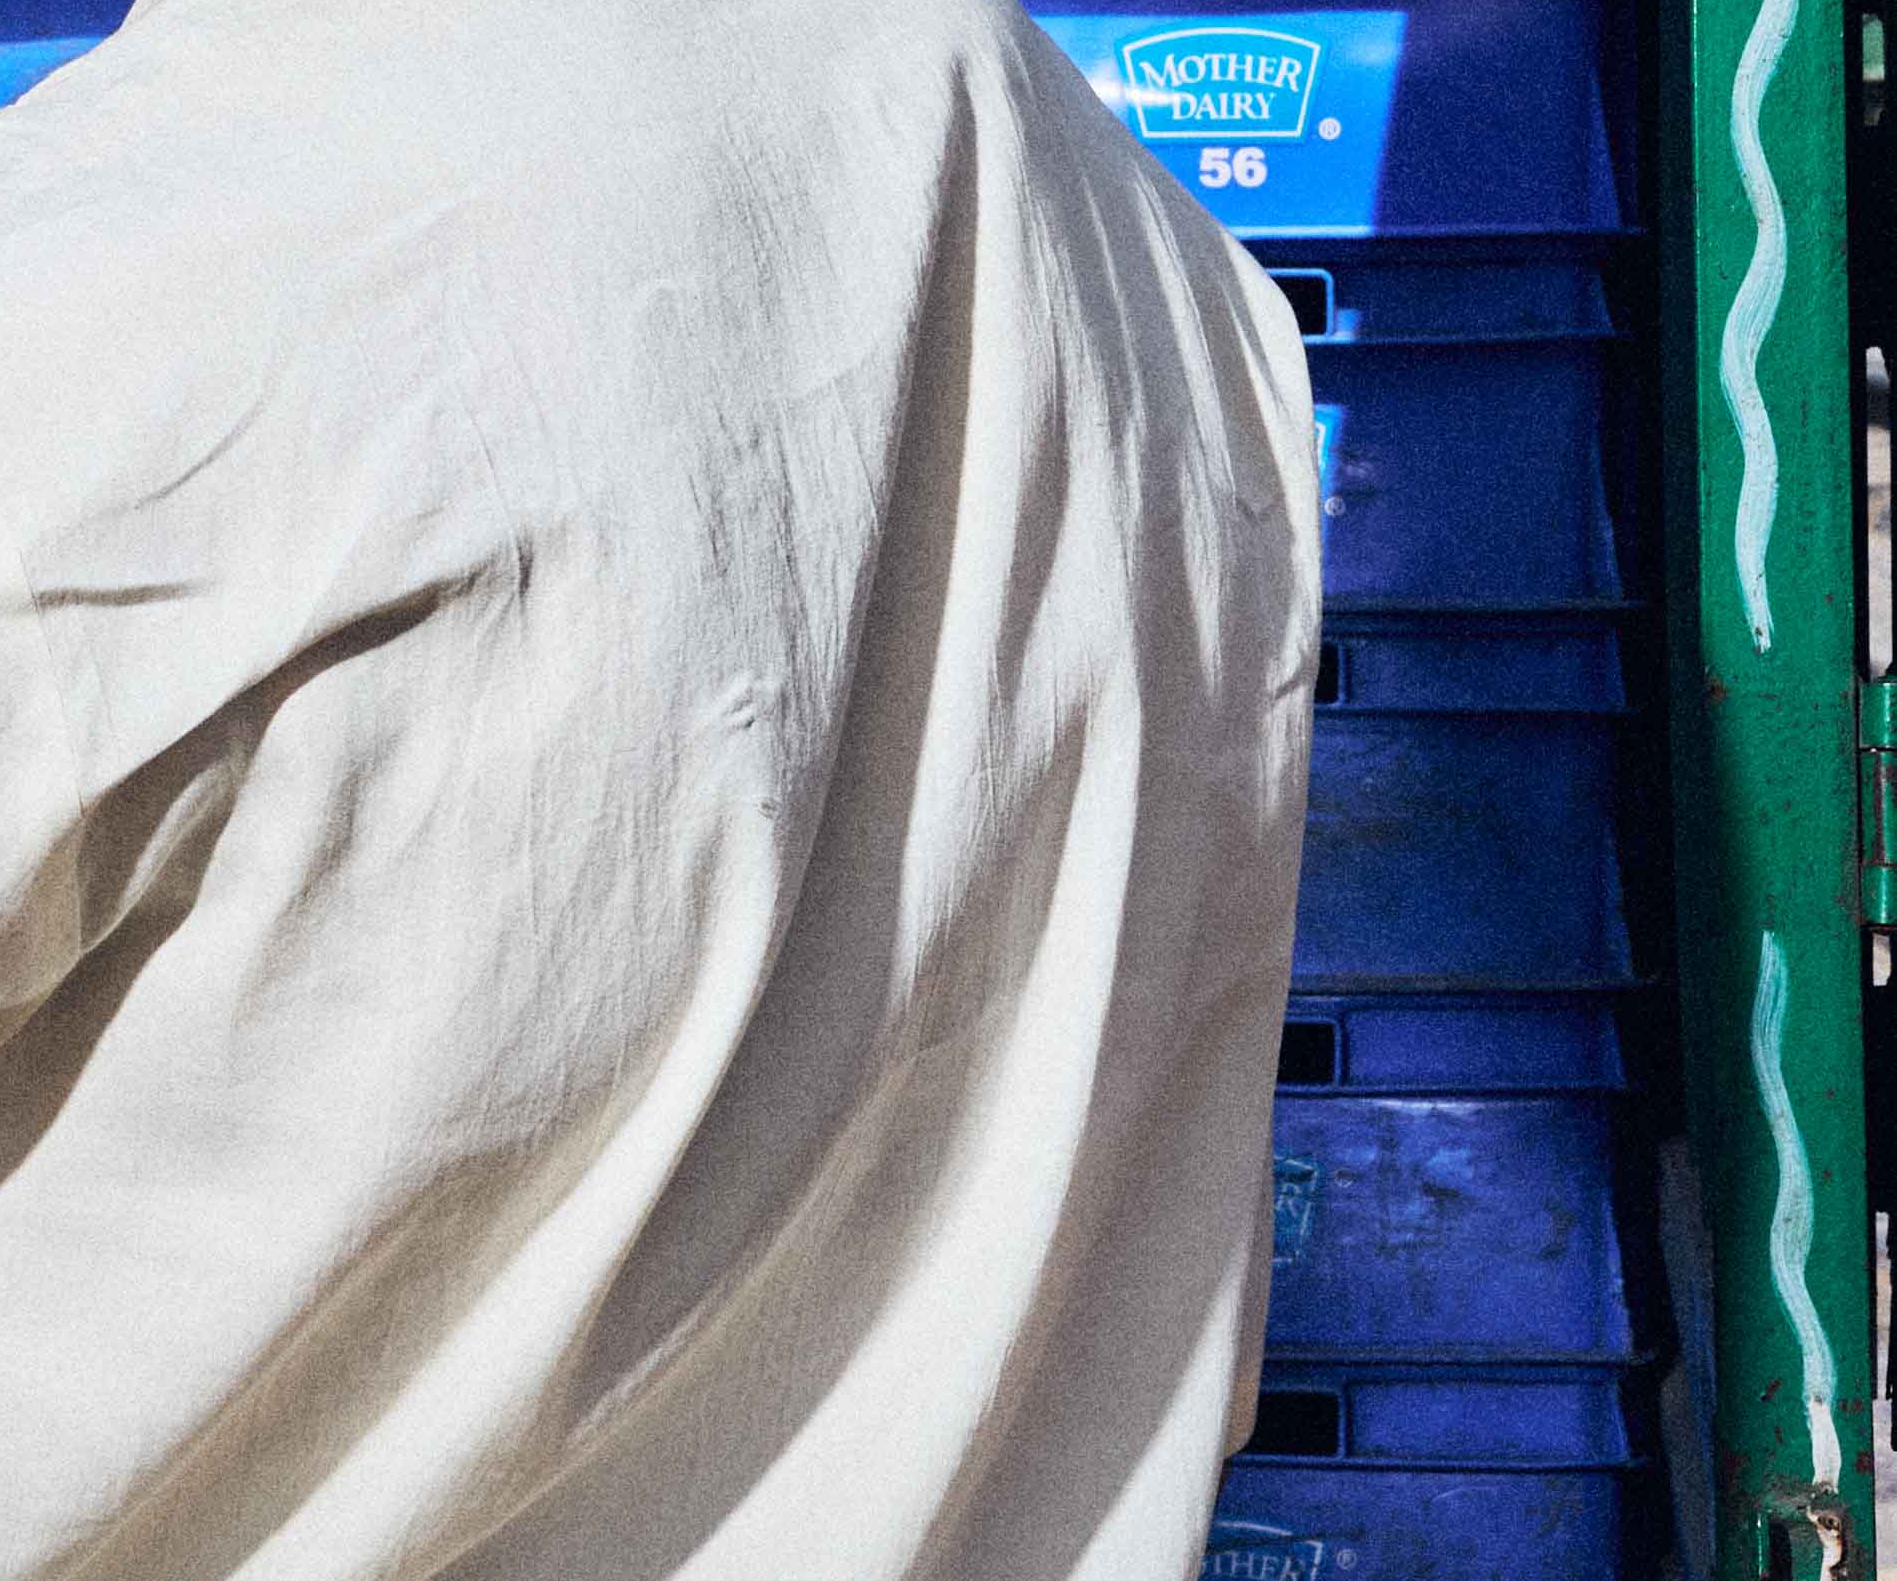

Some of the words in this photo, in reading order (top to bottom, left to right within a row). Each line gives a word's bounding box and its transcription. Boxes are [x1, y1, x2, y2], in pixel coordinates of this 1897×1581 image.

[1139, 53, 1302, 93] MOTHER
[1172, 92, 1276, 120] DAIRY
[1199, 147, 1267, 188] 56
